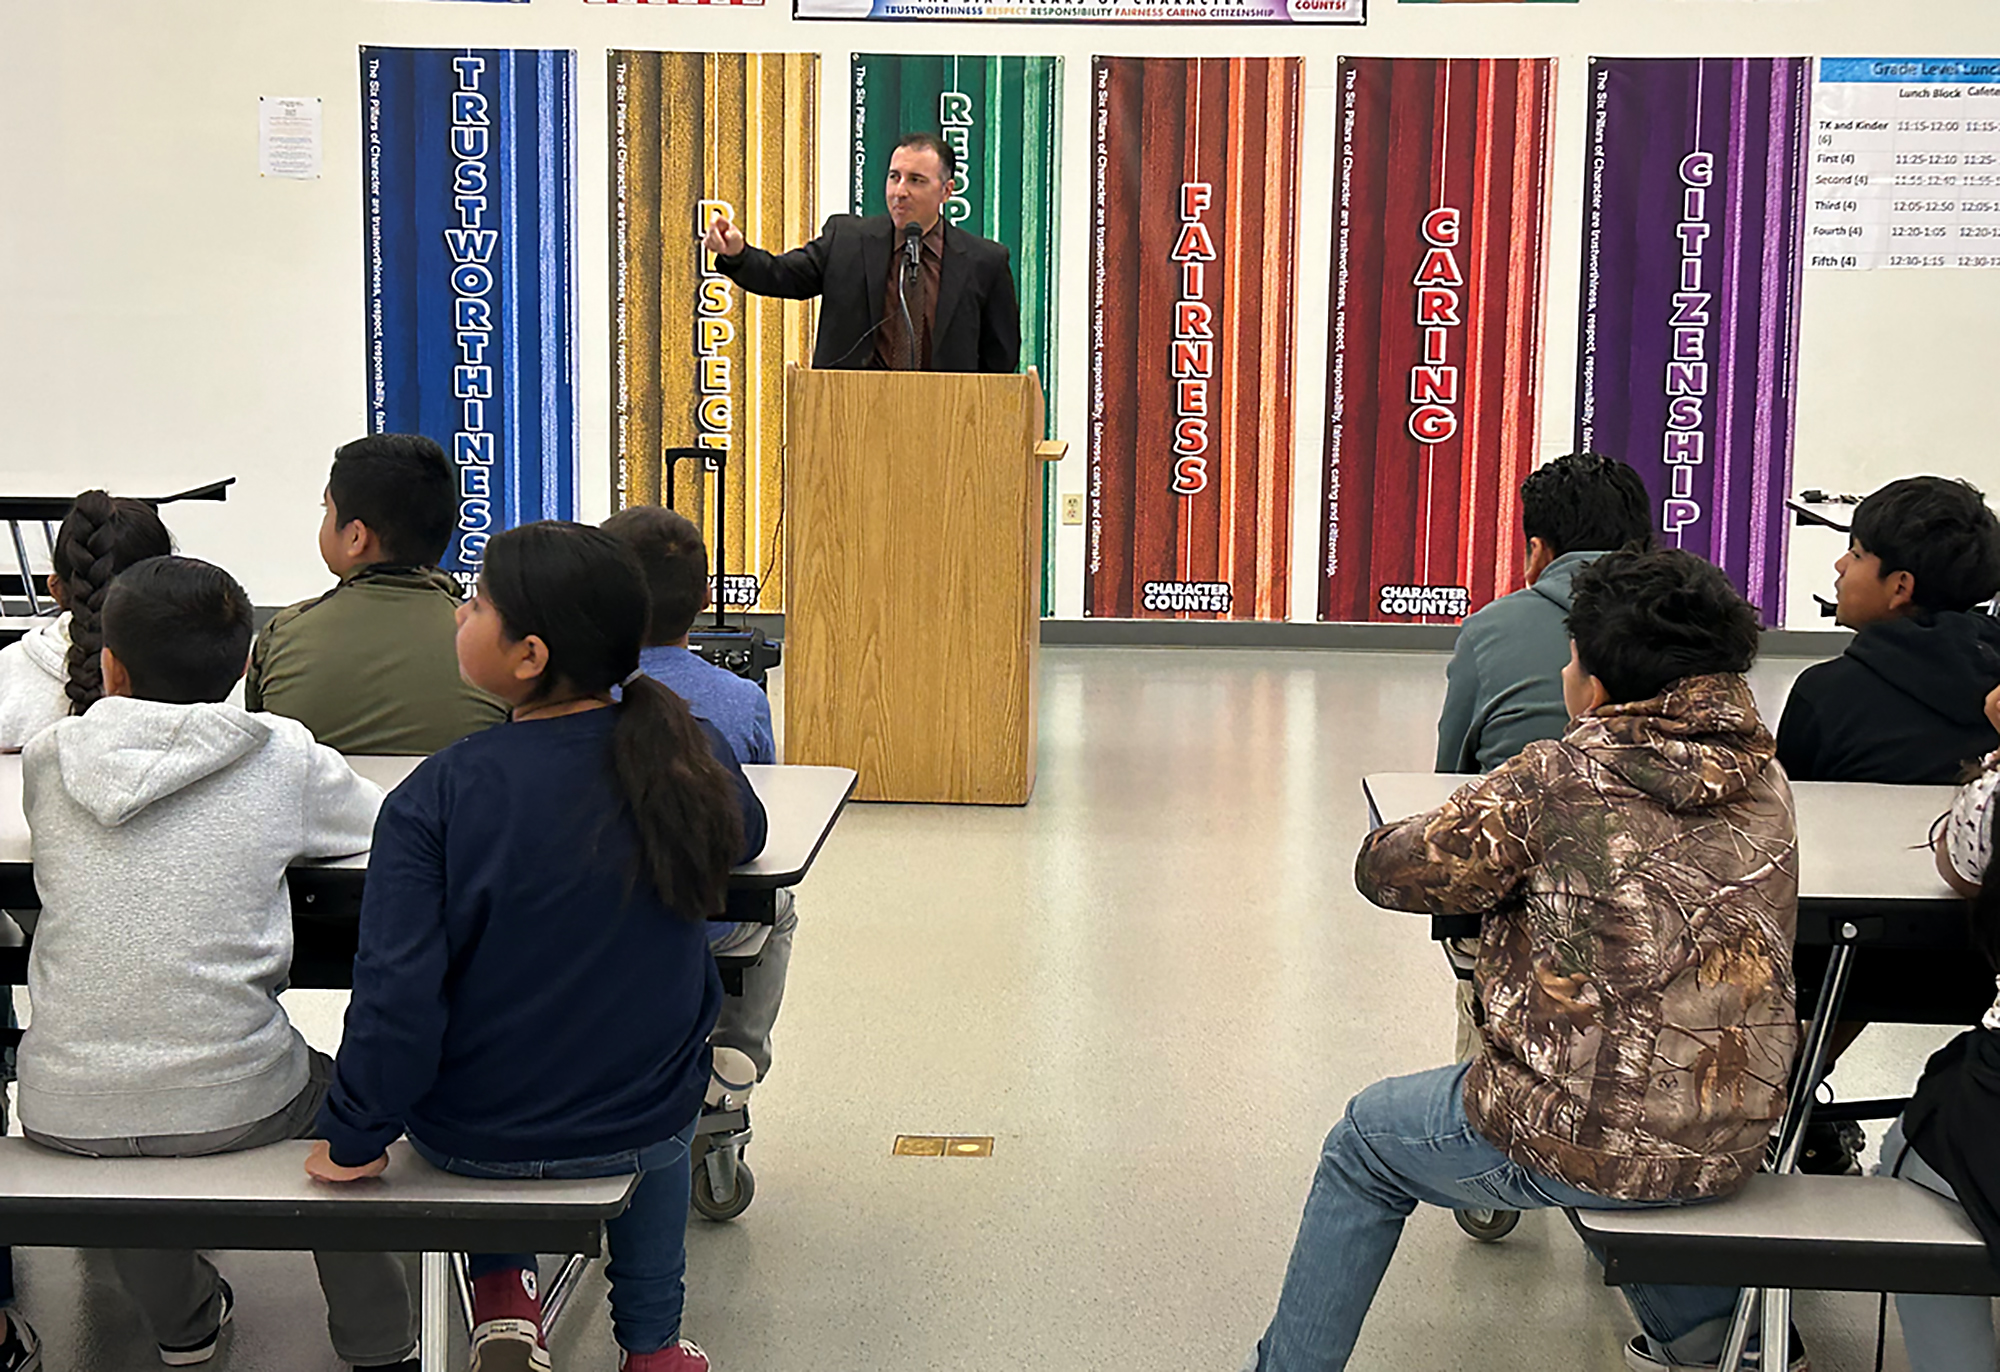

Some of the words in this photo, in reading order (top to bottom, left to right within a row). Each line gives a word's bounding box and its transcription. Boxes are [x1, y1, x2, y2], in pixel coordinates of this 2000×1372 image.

[885, 5, 983, 15] TRUSTWORTHINESS
[986, 7, 1027, 15] RESPECT
[1031, 7, 1112, 16] RESPONSIBILITY
[1115, 8, 1163, 17] FAIRNESS
[1166, 8, 1207, 17] CARING
[1209, 8, 1275, 17] CITIZENSHIP
[1295, 0, 1346, 10] COUNTS!
[369, 59, 380, 79] The
[616, 62, 627, 84] The
[855, 65, 866, 87] The
[1873, 61, 1917, 76] Grade
[1921, 62, 1959, 76] Level
[369, 79, 380, 97] Six
[1098, 68, 1109, 90] The
[1345, 69, 1357, 90] The
[1596, 70, 1609, 91] The
[616, 84, 627, 102] Six
[855, 87, 866, 105] Six
[1098, 90, 1109, 108] Six
[1344, 91, 1356, 110] Six
[1596, 91, 1608, 110] Six
[1899, 88, 1930, 98] Lunch
[1932, 87, 1961, 98] Block
[369, 98, 380, 131] Pillars
[617, 102, 627, 136] Pillars
[855, 106, 866, 139] Pillars
[1097, 108, 1108, 142] Pillars
[1343, 110, 1355, 143] Pillars
[1595, 111, 1607, 143] Pillars
[1819, 120, 1832, 130] TK
[1834, 120, 1853, 130] and
[1855, 120, 1889, 131] Kinder
[370, 132, 381, 144] of
[616, 136, 628, 149] of
[855, 139, 866, 152] of
[1097, 142, 1108, 156] of
[1343, 143, 1354, 157] of
[1594, 144, 1605, 157] of
[1817, 153, 1839, 163] First
[1840, 153, 1855, 165] (4)
[370, 144, 381, 195] Character
[617, 149, 628, 201] Character
[854, 152, 866, 203] Character
[1097, 155, 1108, 207] Character
[1341, 156, 1354, 208] Character
[1592, 157, 1605, 208] Character
[1815, 174, 1853, 185] Second
[1854, 174, 1868, 186] (4)
[371, 197, 380, 215] are
[617, 201, 626, 218] are
[1814, 200, 1841, 210] Third
[1843, 200, 1857, 212] (4)
[1096, 208, 1105, 226] are
[1340, 209, 1349, 227] are
[1591, 210, 1601, 228] are
[1812, 226, 1847, 236] Fourth
[1848, 226, 1863, 237] (4)
[1811, 256, 1838, 267] Fifth
[1840, 256, 1857, 268] (4)
[445, 57, 497, 565] TRUSTWORTHINESS
[1408, 207, 1463, 443] CARING
[1171, 183, 1216, 494] FAIRNESS
[1663, 152, 1713, 532] CITIZENSHIP
[616, 458, 629, 491] caring
[1090, 465, 1103, 498] caring
[1328, 468, 1341, 501] caring
[1091, 498, 1102, 519] and
[1329, 501, 1339, 521] and
[1144, 582, 1229, 597] CHARACTER
[1380, 585, 1467, 601] CHARACTER
[1144, 595, 1229, 612] COUNTS!
[1380, 599, 1467, 616] COUNTS!
